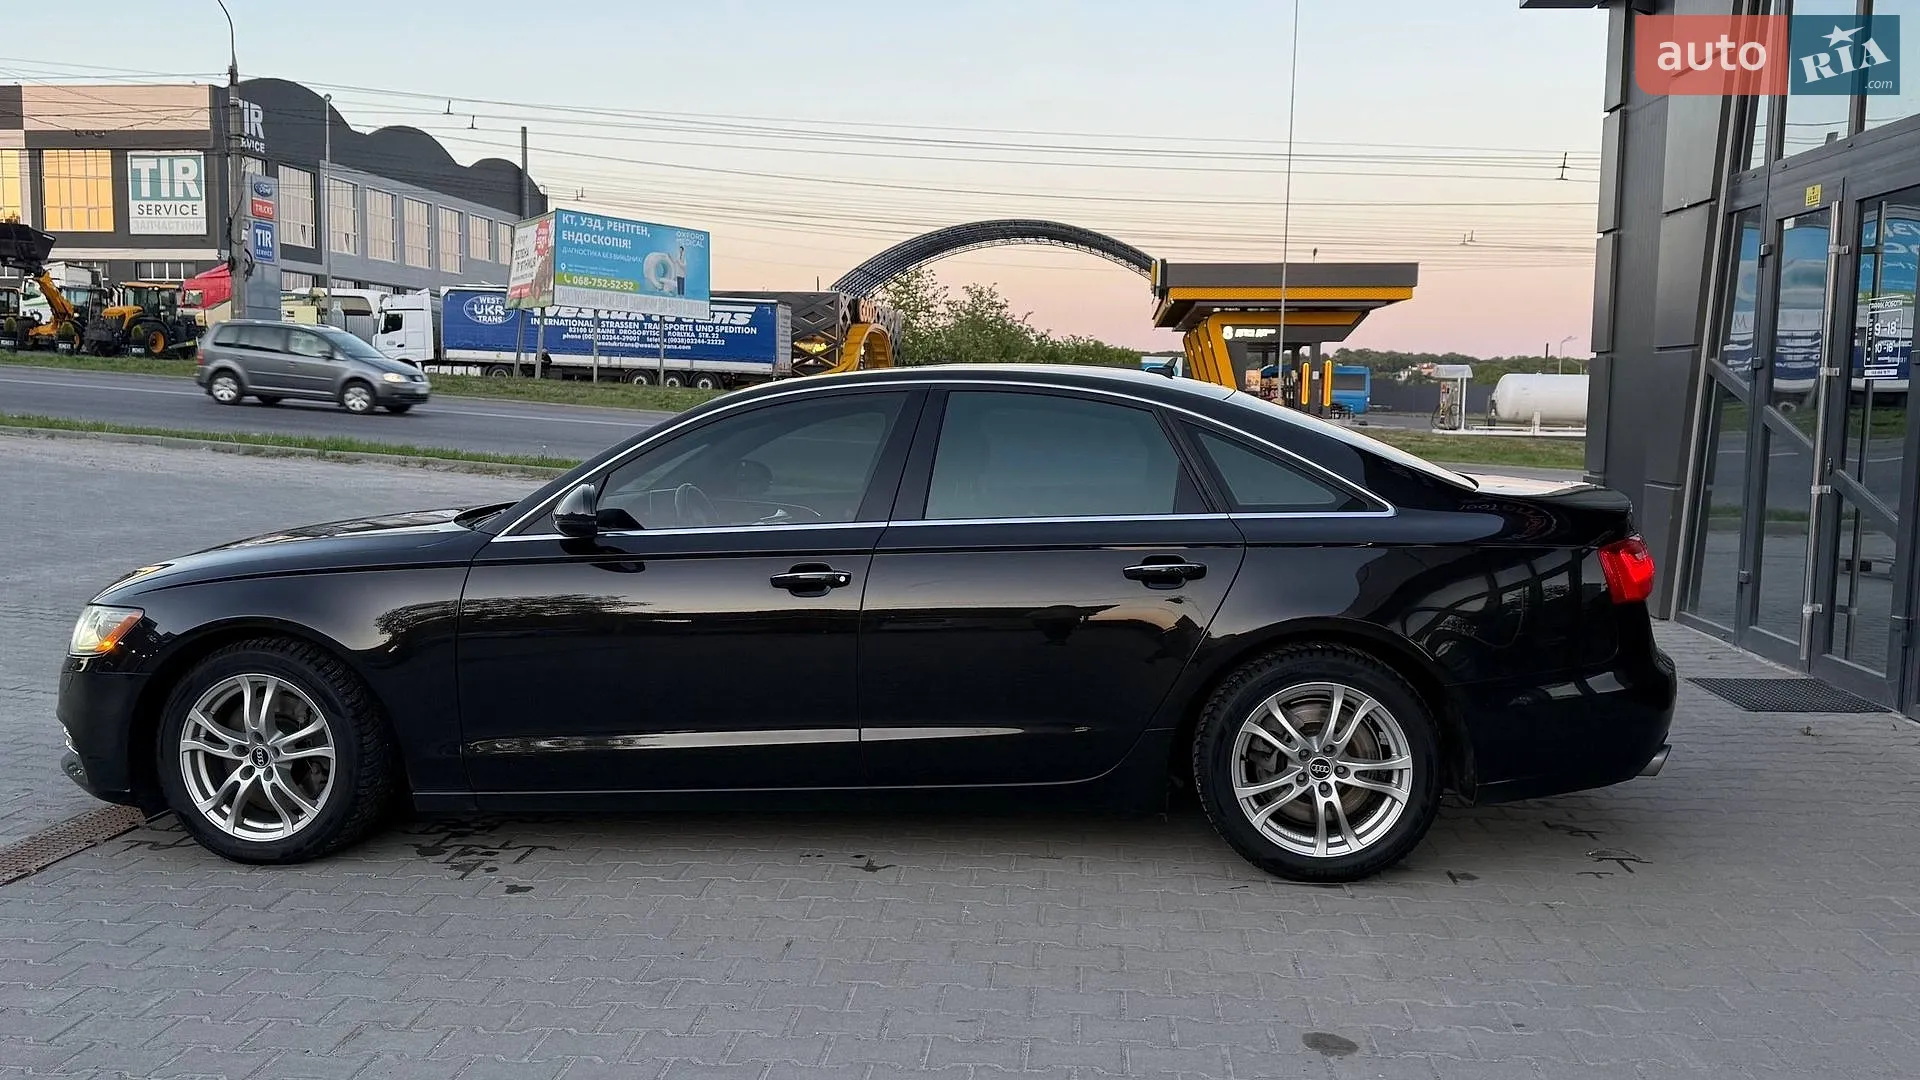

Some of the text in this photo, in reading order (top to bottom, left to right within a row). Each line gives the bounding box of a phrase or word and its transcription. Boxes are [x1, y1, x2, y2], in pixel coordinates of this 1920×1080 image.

[132, 158, 200, 198] TIR
[137, 204, 198, 216] SERVICE
[255, 203, 273, 215] TRUCKS
[562, 213, 650, 238] КТ, УЗД, РЕНТГЕН,
[255, 228, 273, 248] TIR
[562, 230, 632, 249] ЕНДОСКОПІЯ!
[572, 274, 634, 291] 068-752-52-52
[480, 296, 500, 304] WEST
[474, 304, 505, 316] UKR
[477, 315, 503, 324] TRANS
[531, 318, 594, 327] INERNATIONAL
[600, 320, 640, 330] STRASSEN
[695, 325, 714, 333] UND
[715, 325, 757, 335] SPEDITION
